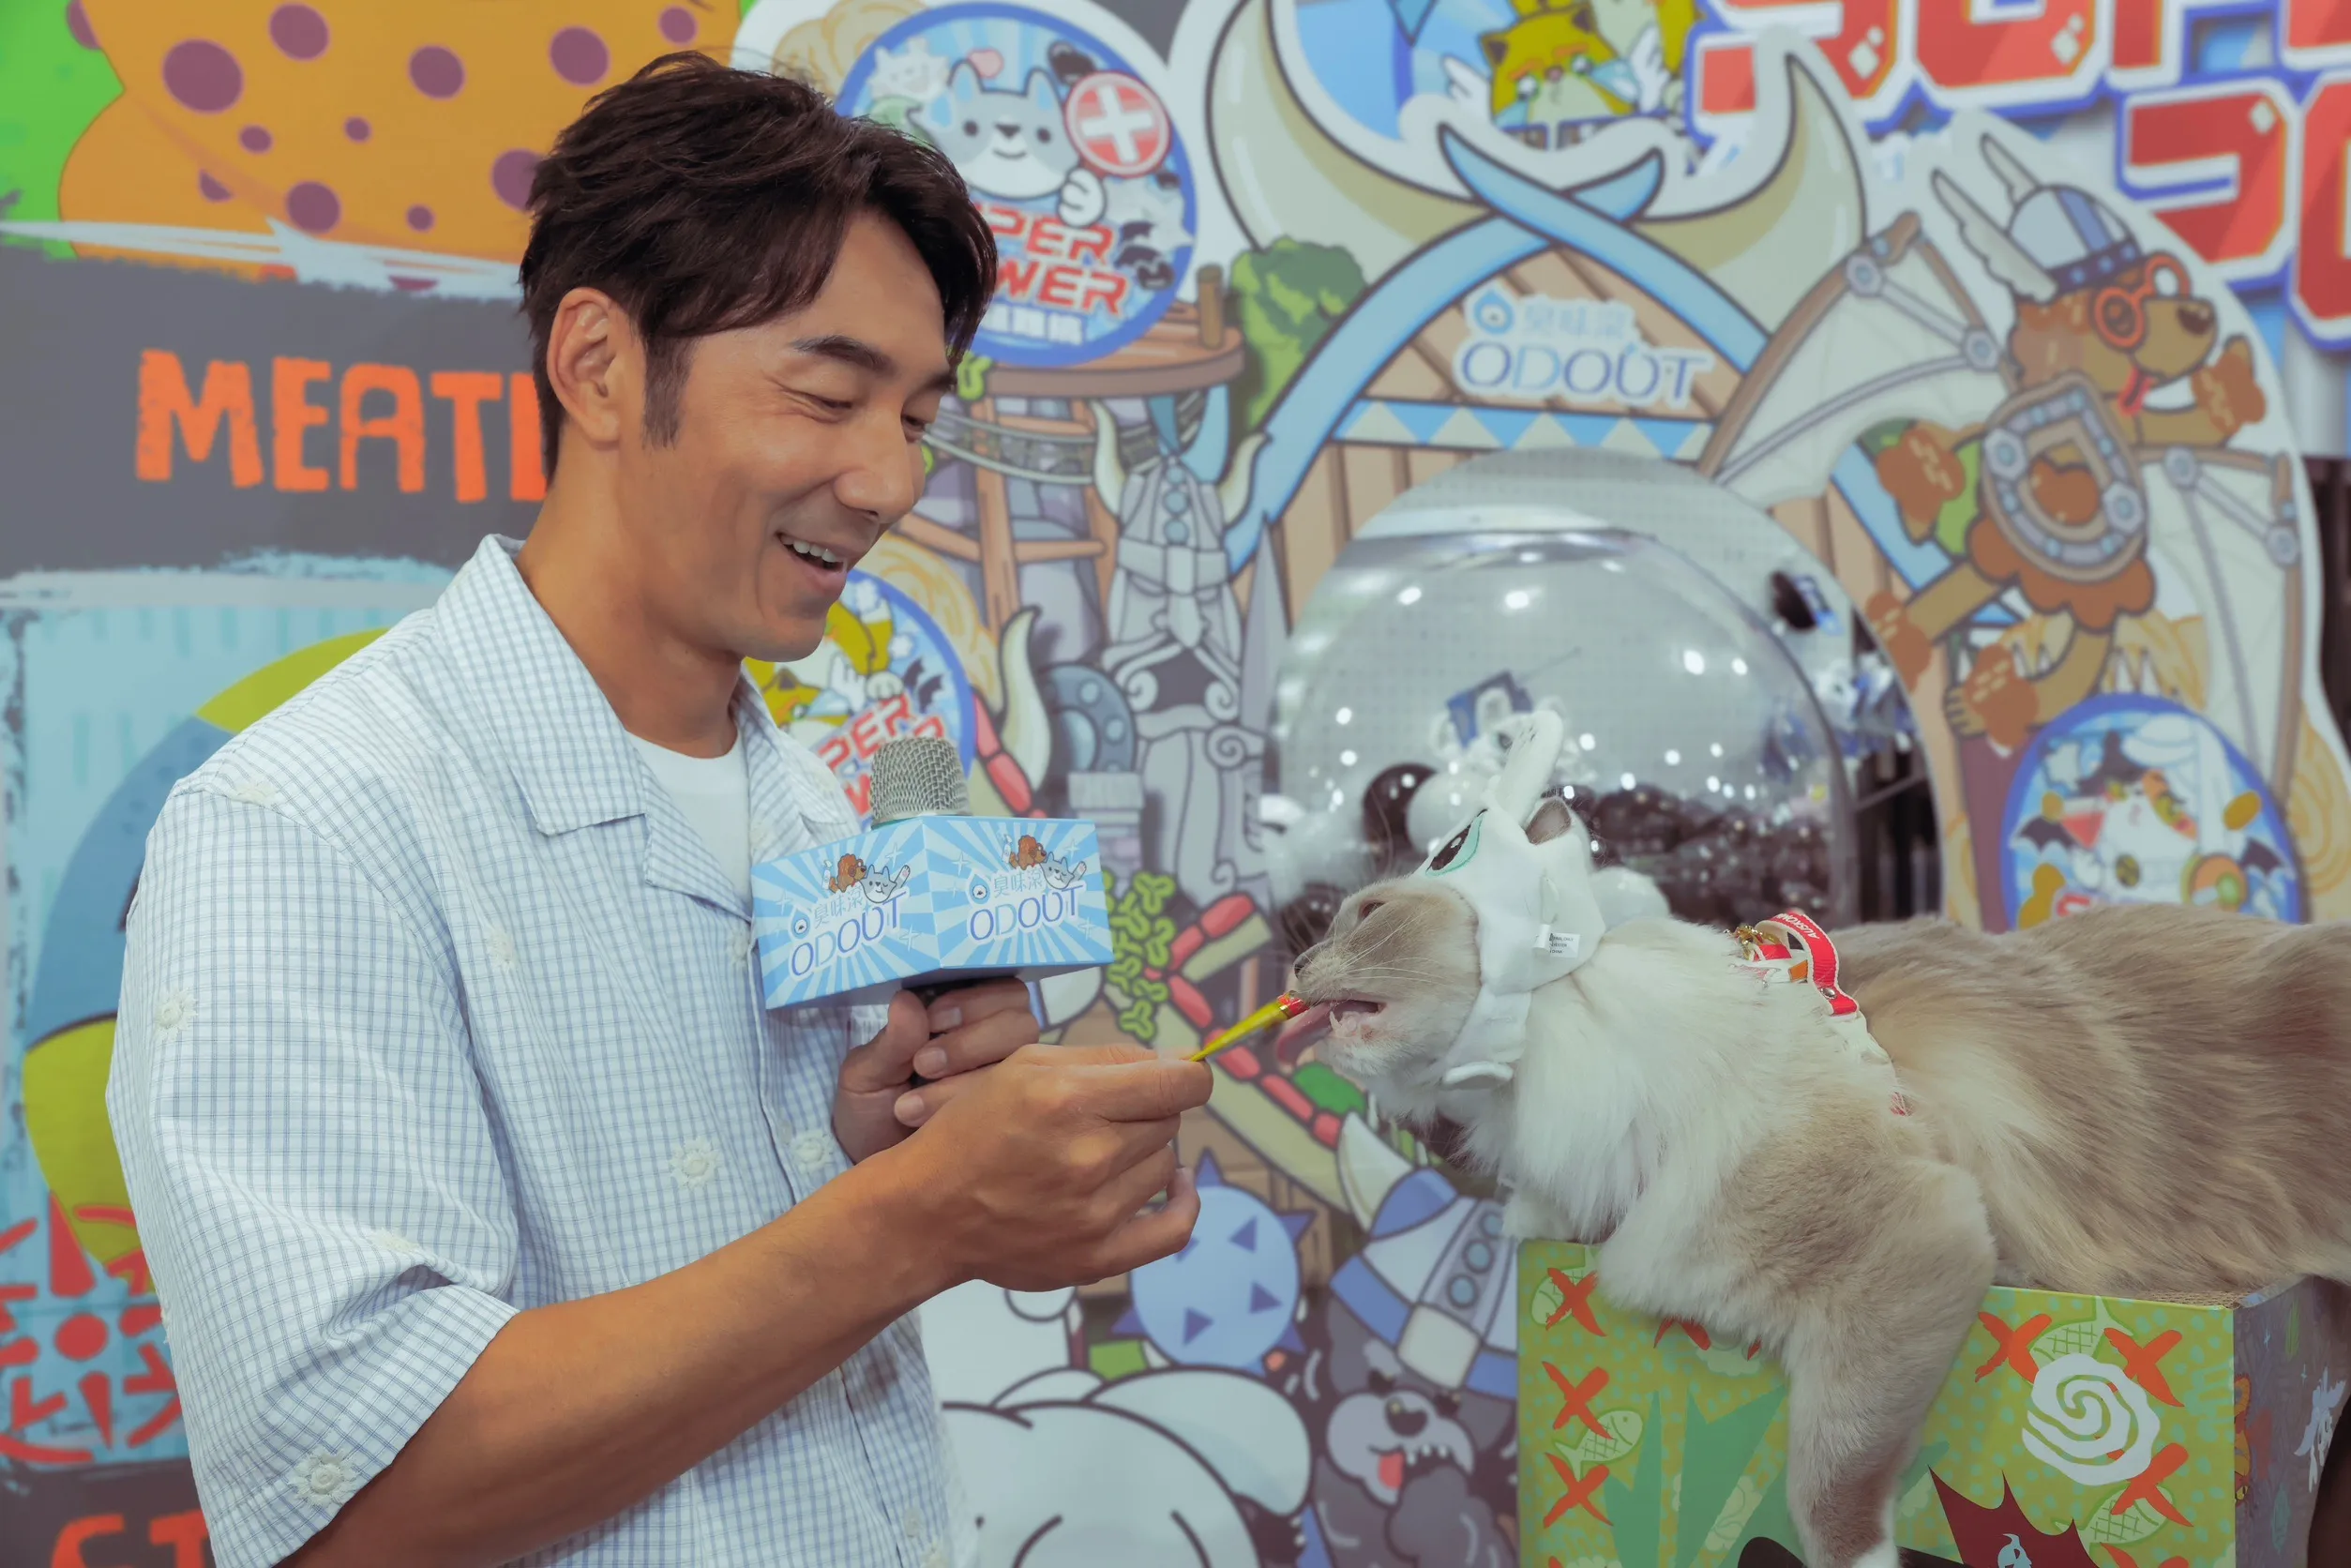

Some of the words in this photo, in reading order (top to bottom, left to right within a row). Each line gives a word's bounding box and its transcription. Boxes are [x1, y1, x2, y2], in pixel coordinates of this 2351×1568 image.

[1462, 340, 1707, 401] ODOUT
[791, 891, 907, 976] ODOUT
[970, 884, 1084, 941] ODOUT
